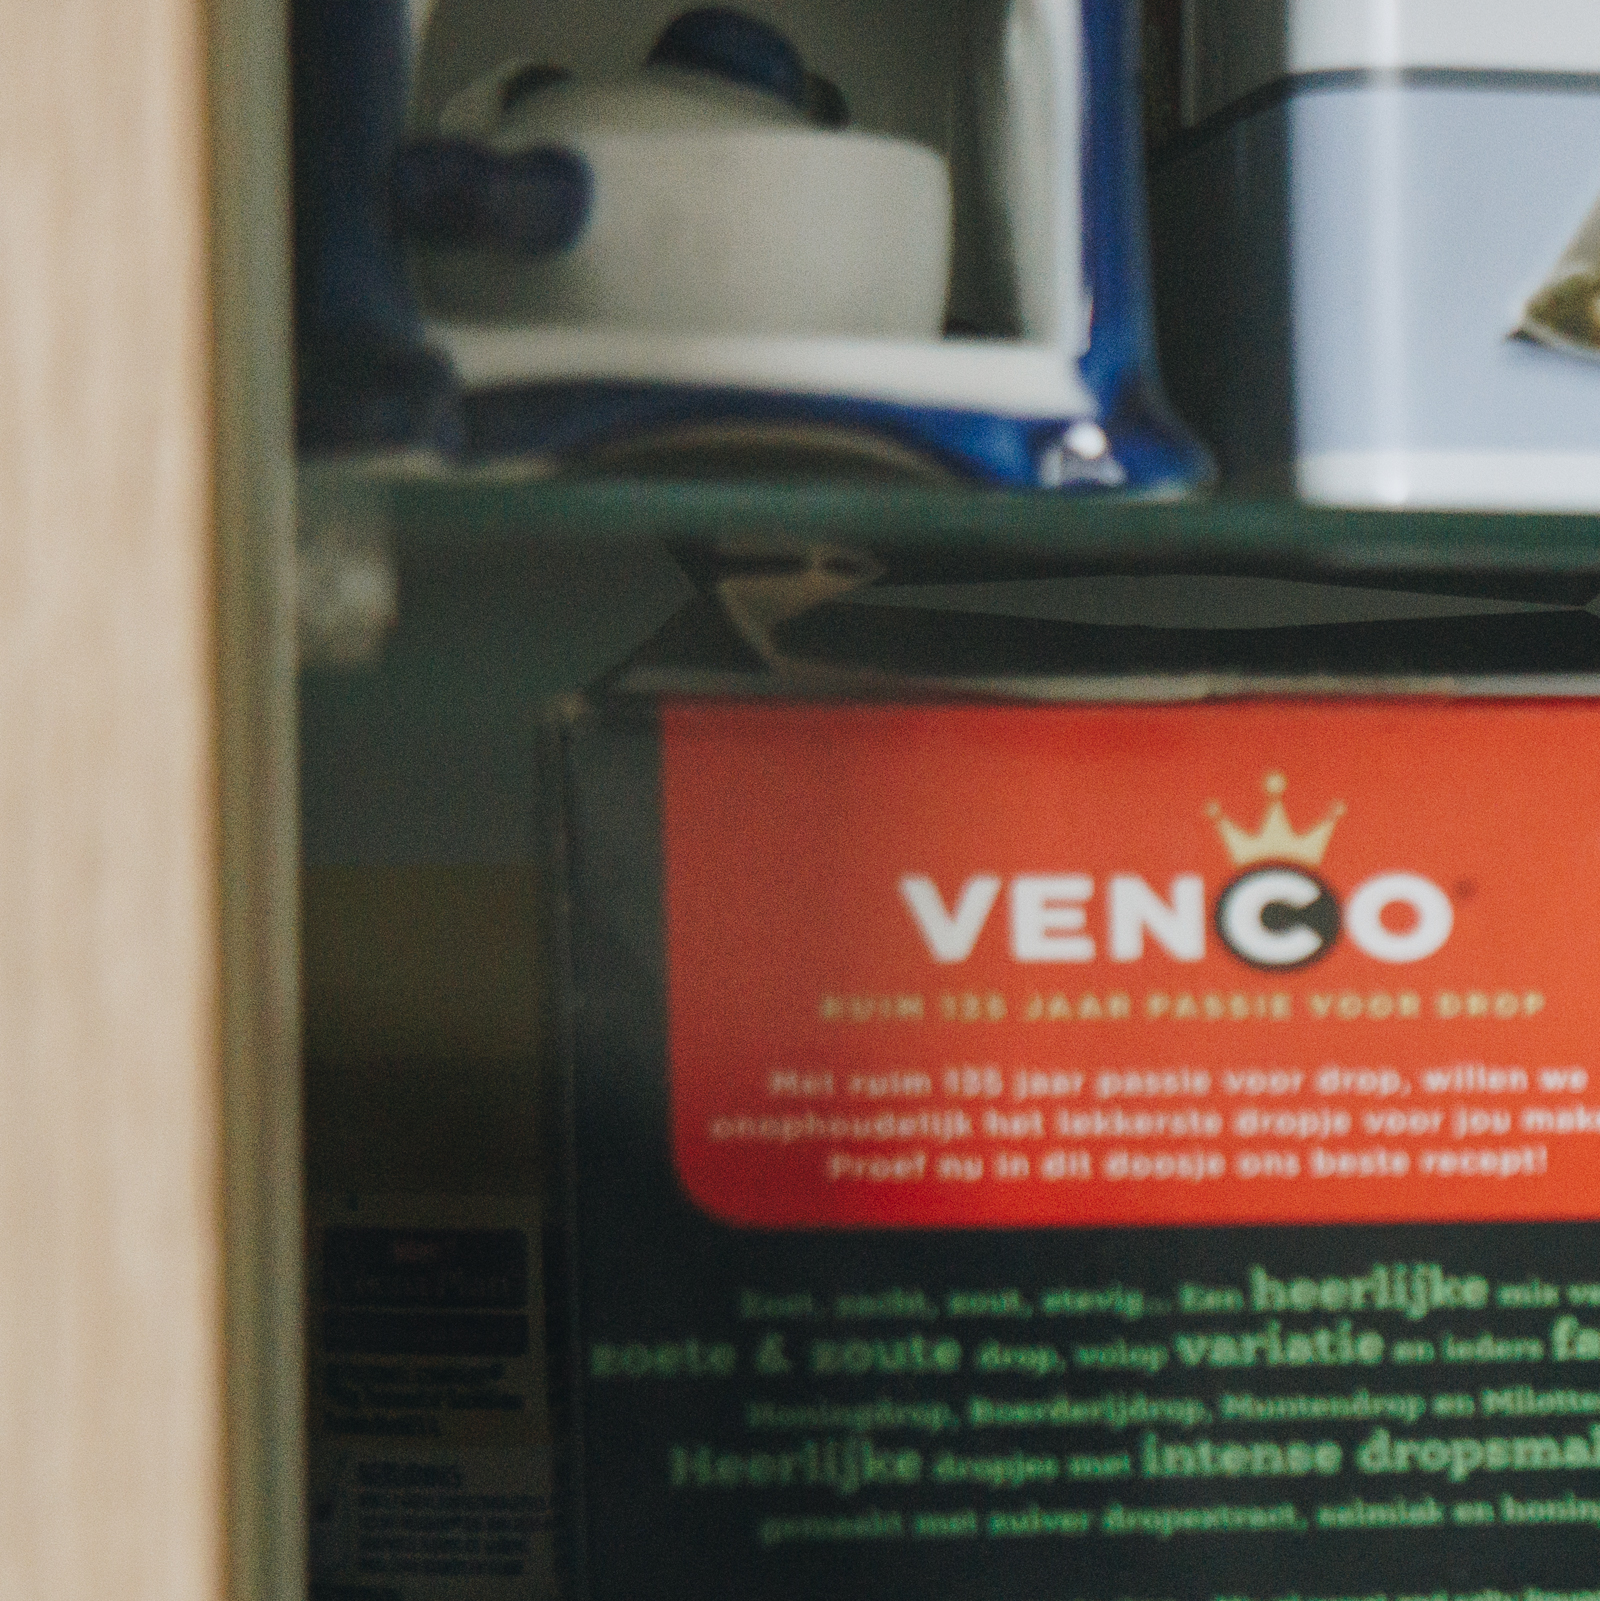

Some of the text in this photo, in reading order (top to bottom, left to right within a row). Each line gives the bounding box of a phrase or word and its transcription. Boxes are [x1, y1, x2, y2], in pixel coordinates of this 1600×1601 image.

[900, 870, 1455, 965] VENCO
[1025, 991, 1130, 1021] JAAR
[1146, 990, 1291, 1020] PASSIE
[1307, 989, 1421, 1020] VOOR
[1435, 989, 1546, 1019] DROP
[1013, 1068, 1084, 1100] jaar
[1095, 1065, 1212, 1100] passie
[1223, 1069, 1304, 1096] voor
[1421, 1062, 1528, 1094] willen
[1537, 1068, 1588, 1093] we
[1362, 1110, 1444, 1136] voor
[1452, 1105, 1512, 1140] jou
[938, 1155, 984, 1180] nu
[1234, 1150, 1300, 1179] ons
[1308, 1147, 1410, 1178] beste
[1250, 1262, 1489, 1319] heerlijke
[1175, 1319, 1384, 1368] variatie
[1141, 1431, 1342, 1476] intense
